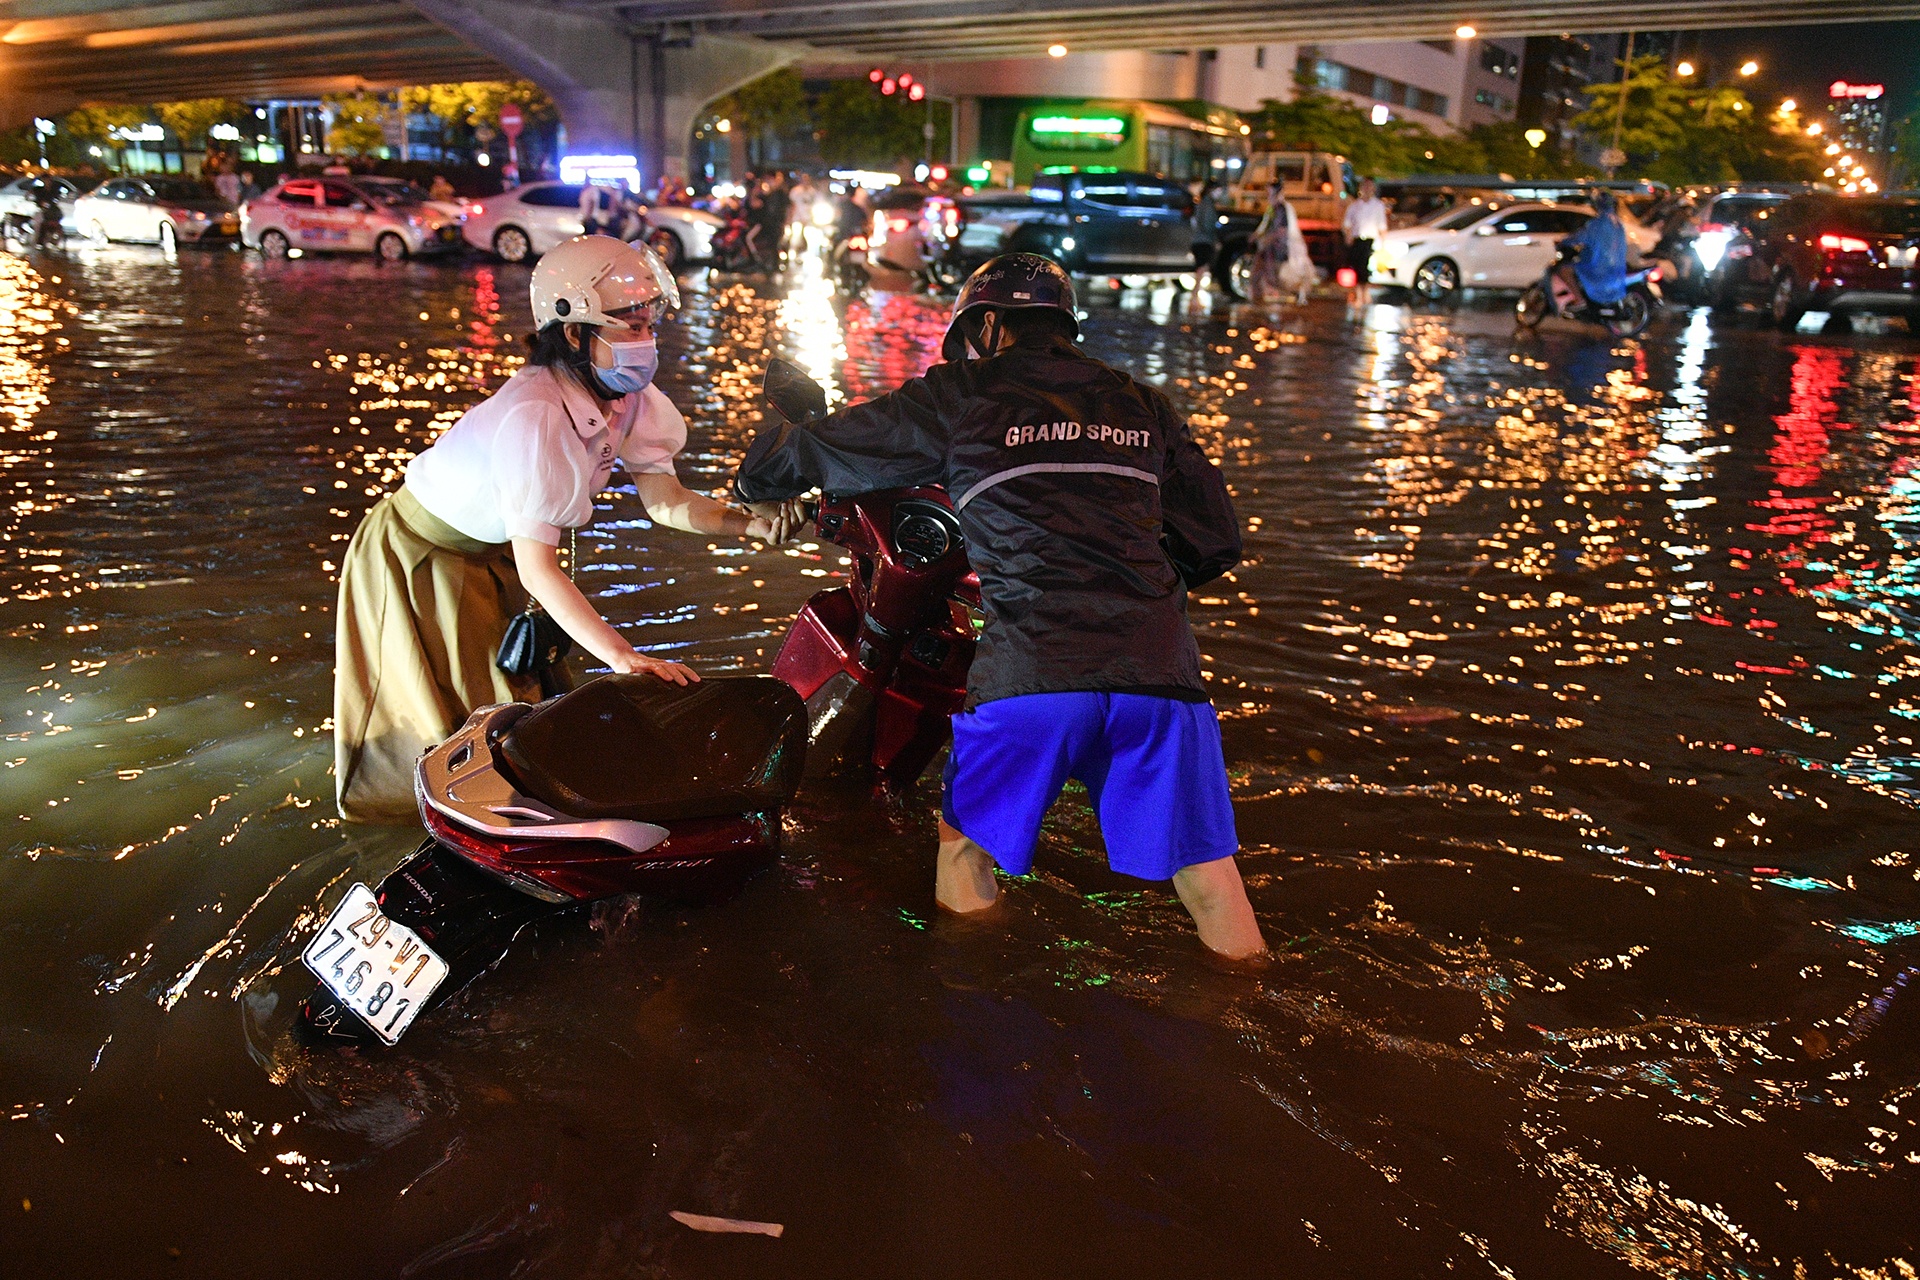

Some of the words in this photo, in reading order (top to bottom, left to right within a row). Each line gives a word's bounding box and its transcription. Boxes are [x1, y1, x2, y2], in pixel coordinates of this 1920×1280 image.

[1005, 421, 1081, 448] GRAND
[1086, 423, 1151, 448] SPORT
[402, 872, 434, 905] HONDA
